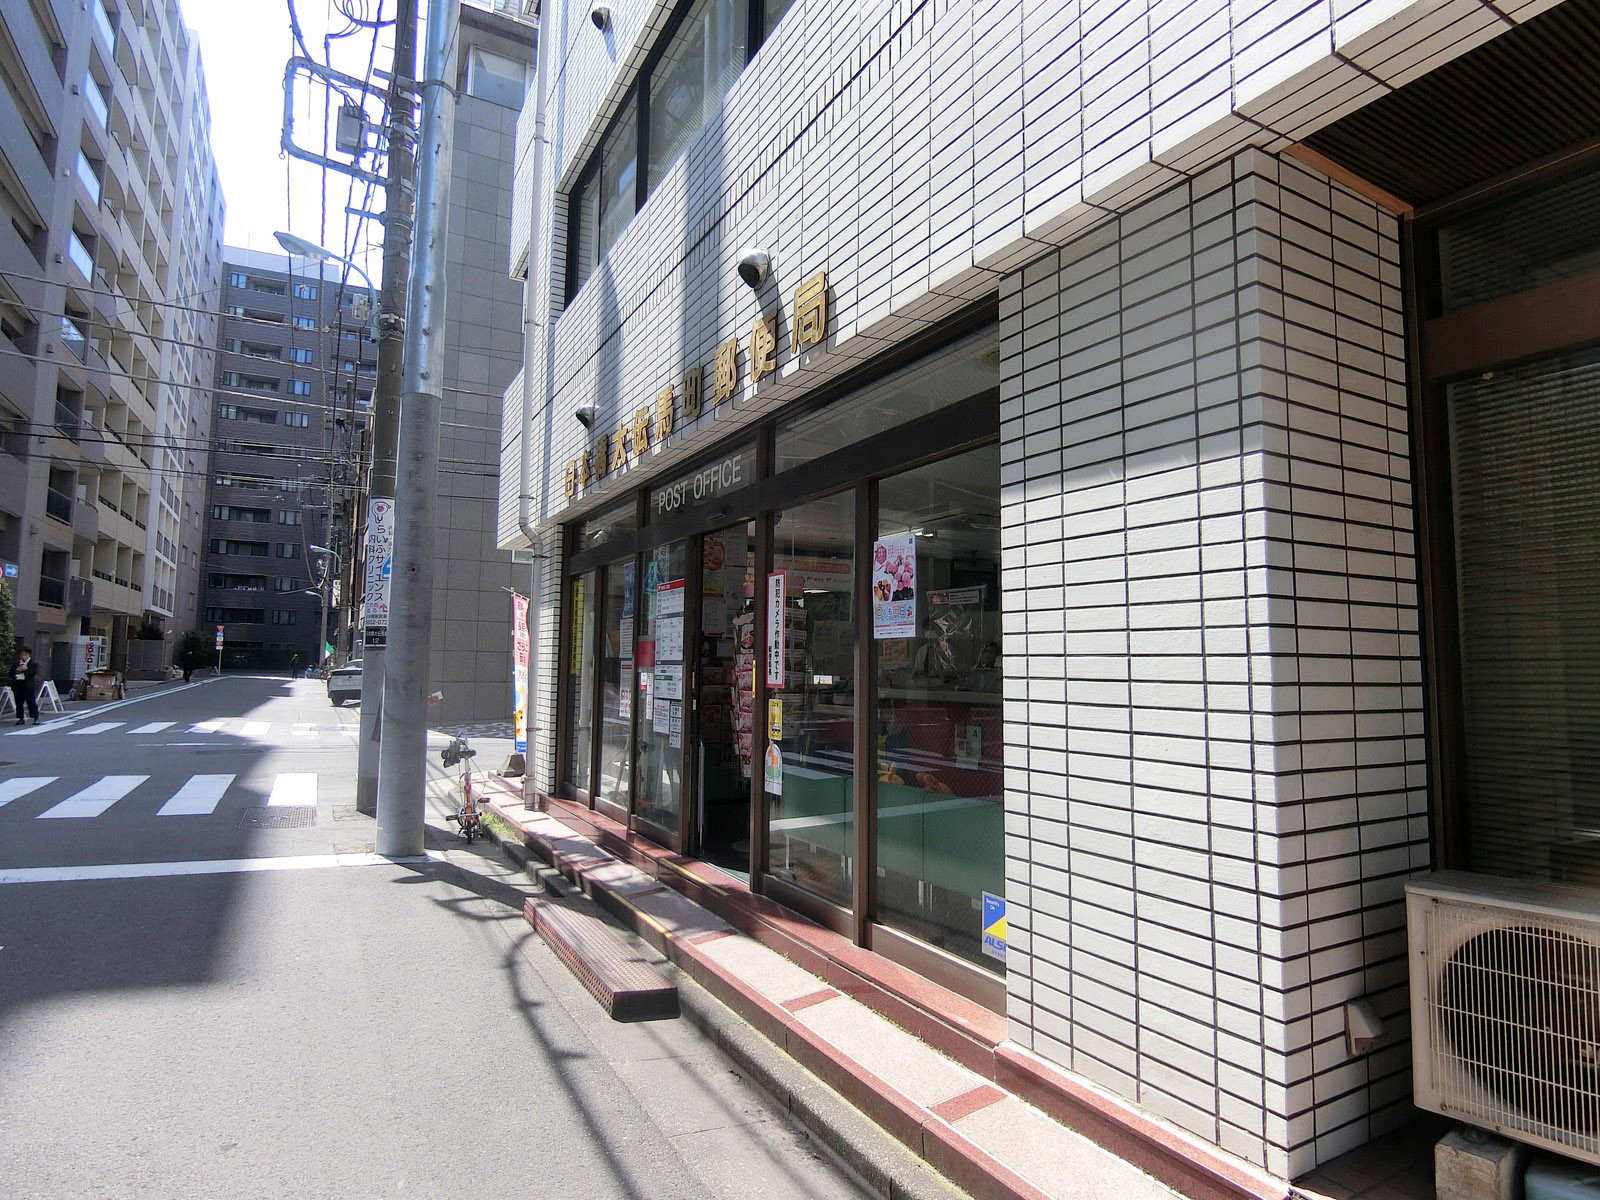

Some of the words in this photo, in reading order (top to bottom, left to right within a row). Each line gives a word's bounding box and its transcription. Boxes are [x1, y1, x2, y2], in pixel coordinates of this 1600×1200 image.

[564, 270, 828, 499] 日本橋大伝馬町郵便局
[658, 480, 688, 515] POST
[693, 454, 743, 500] OFFICE
